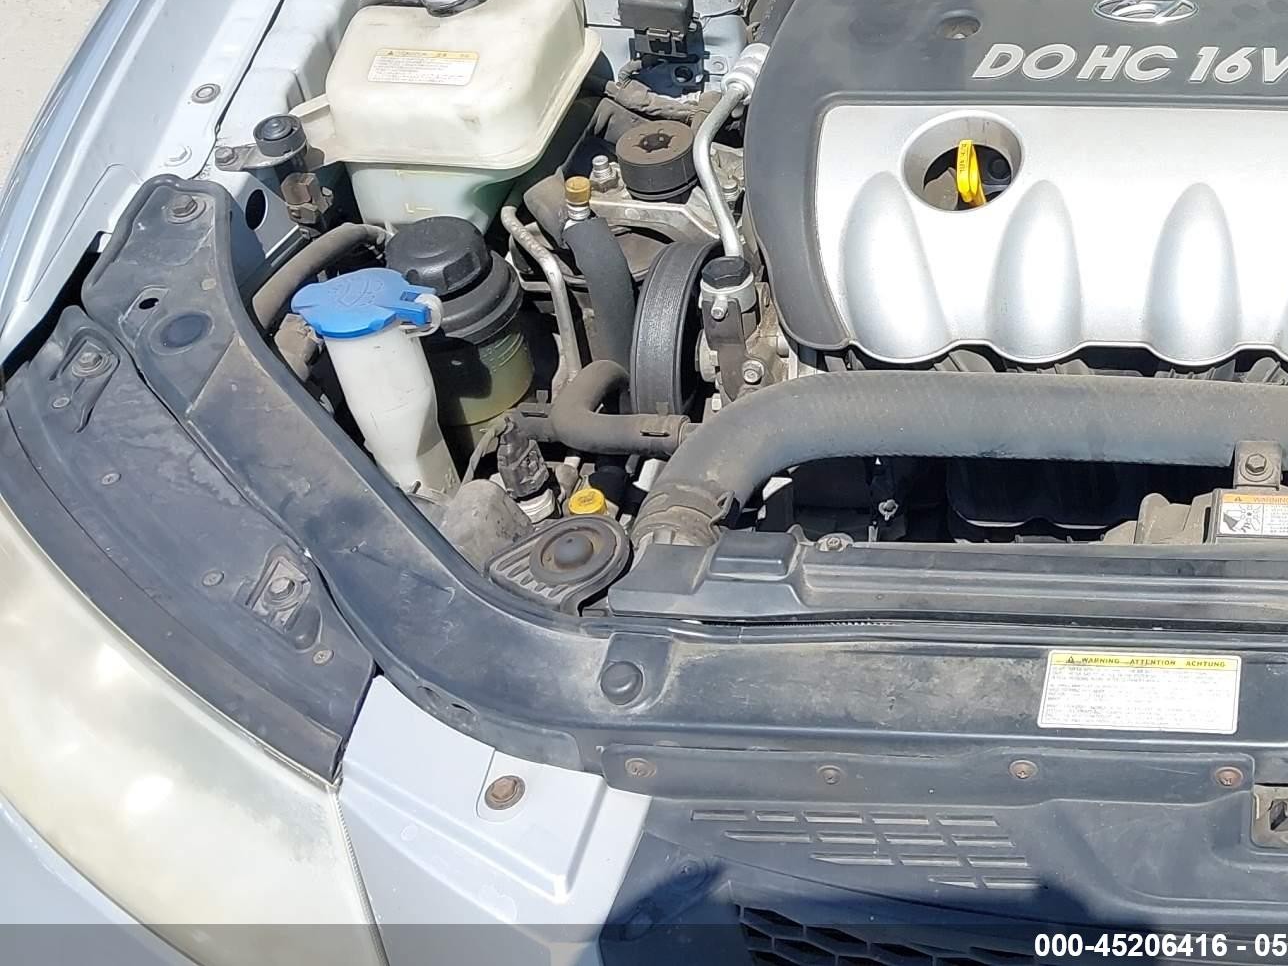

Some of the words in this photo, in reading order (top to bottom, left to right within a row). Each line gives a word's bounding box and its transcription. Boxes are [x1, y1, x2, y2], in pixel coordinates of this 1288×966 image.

[1081, 656, 1121, 665] WARNING
[1129, 658, 1177, 666] ATTENTION
[1185, 660, 1227, 668] ACHTUNG
